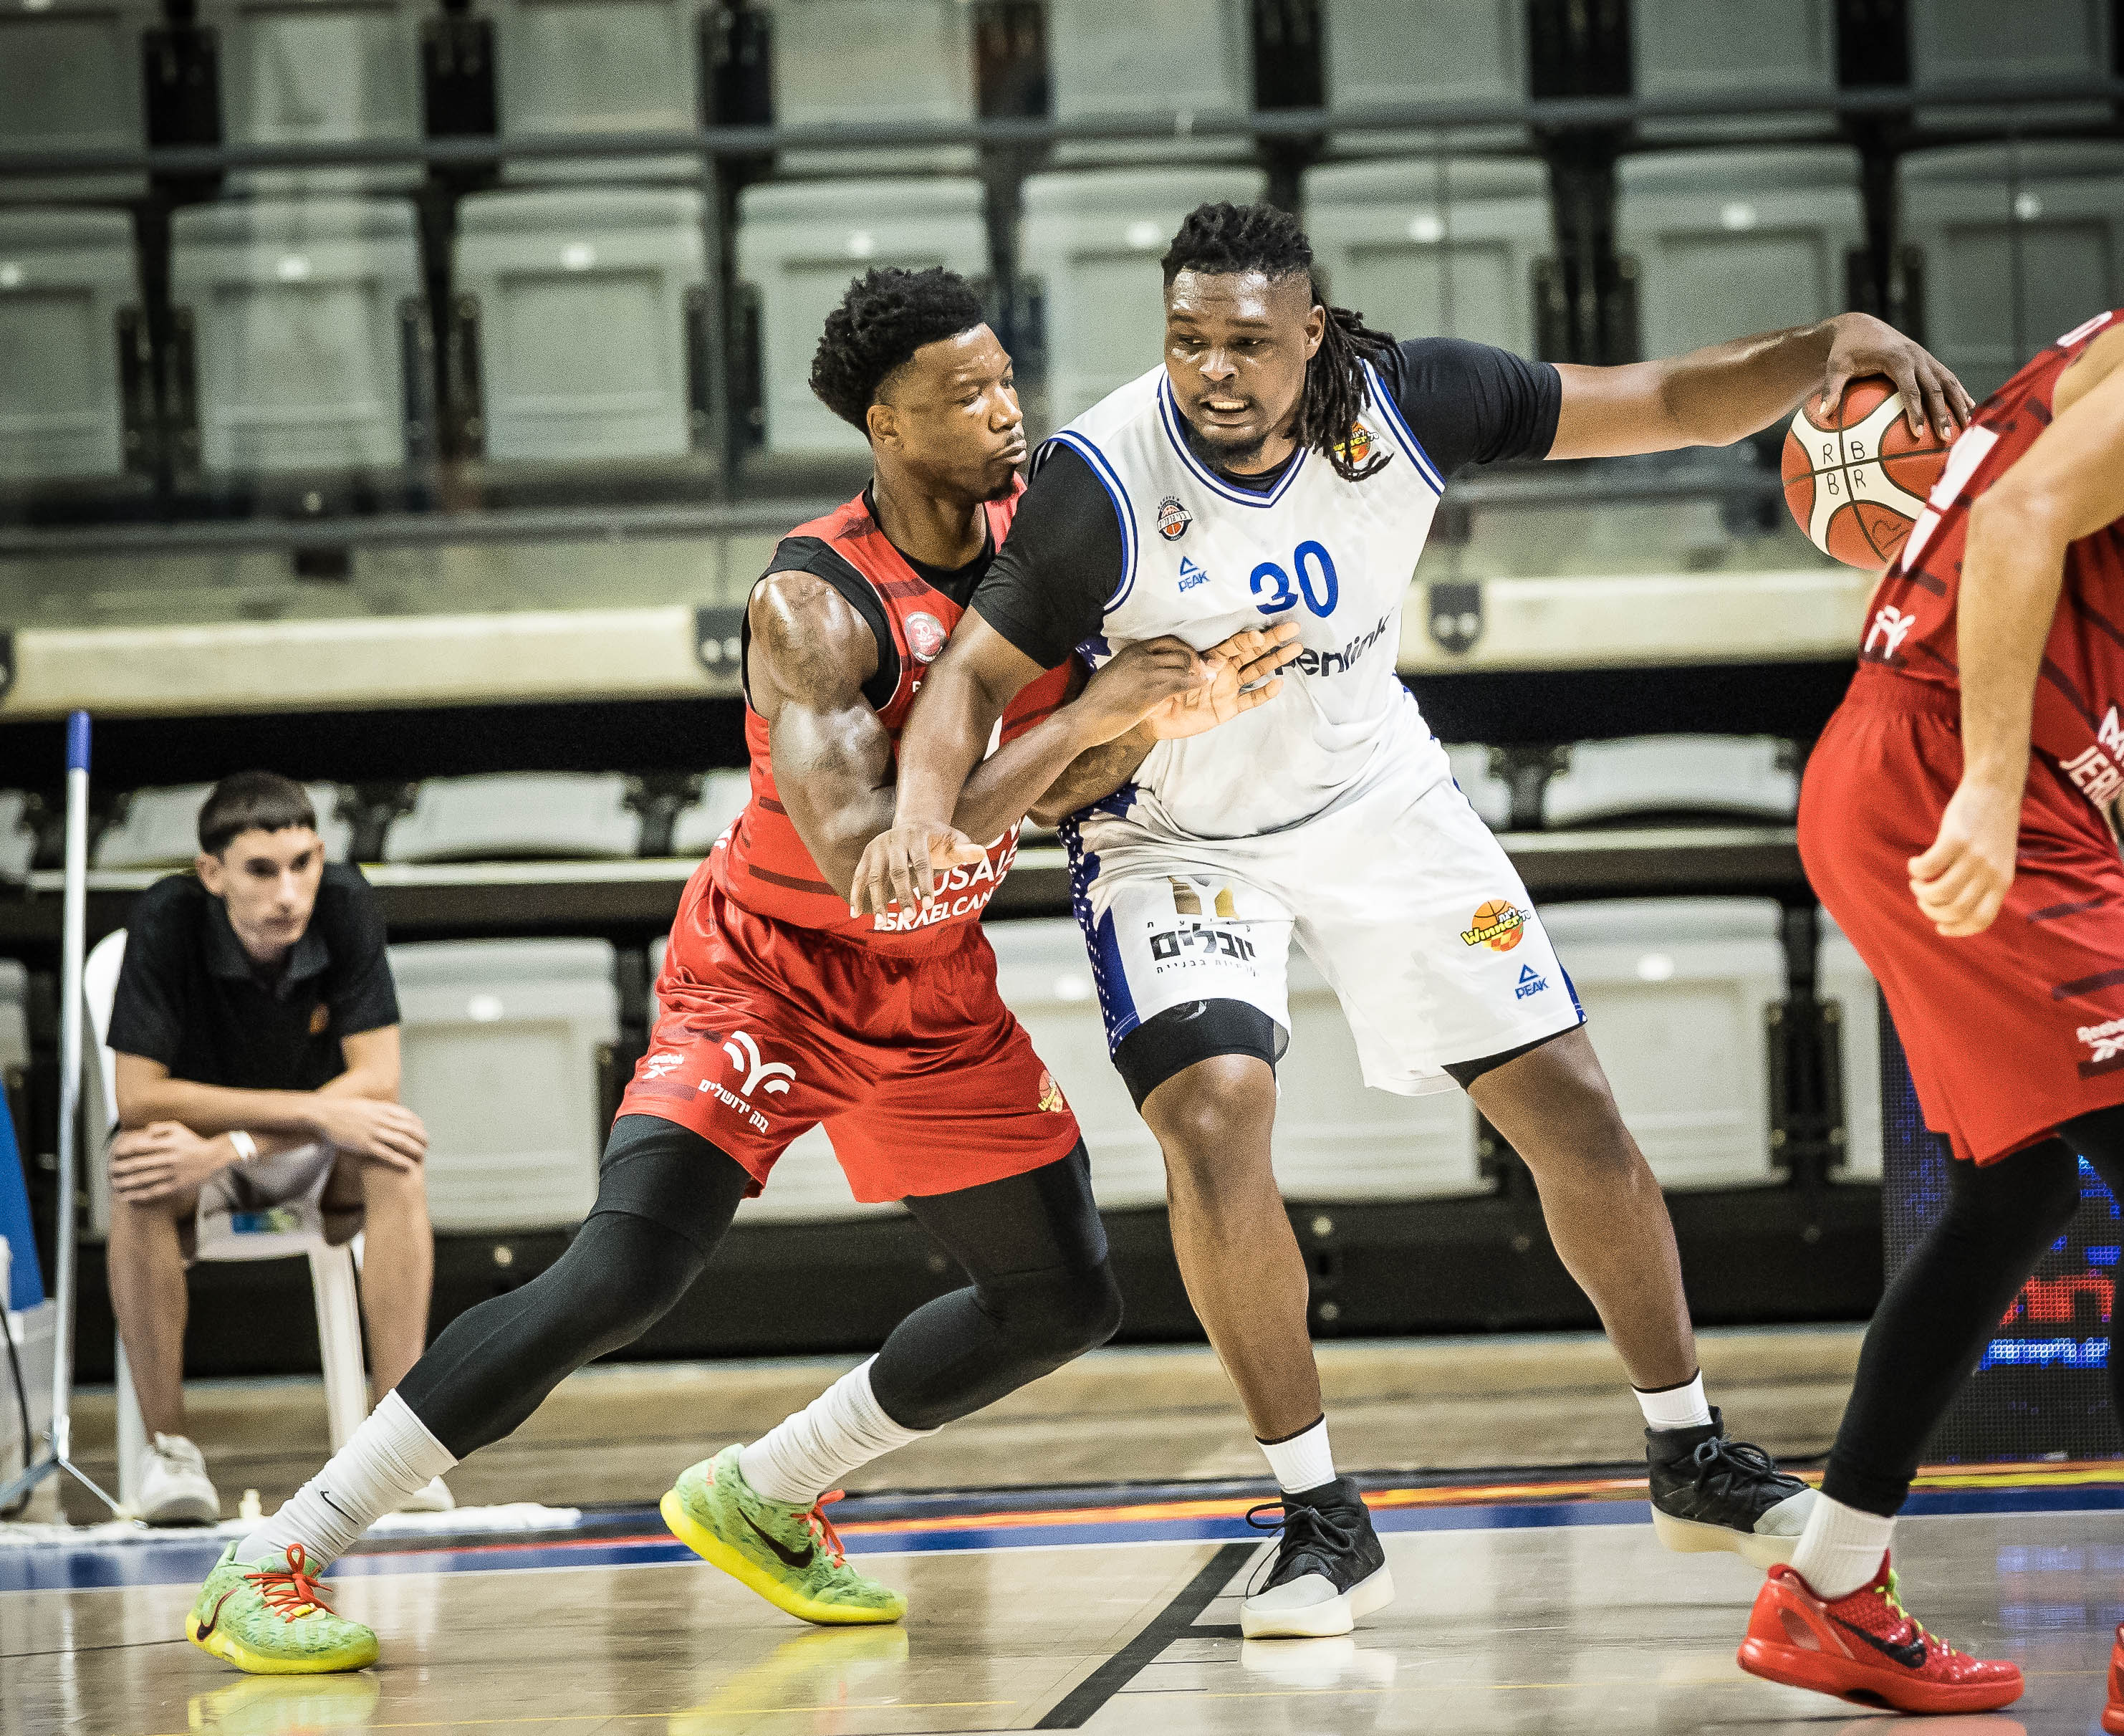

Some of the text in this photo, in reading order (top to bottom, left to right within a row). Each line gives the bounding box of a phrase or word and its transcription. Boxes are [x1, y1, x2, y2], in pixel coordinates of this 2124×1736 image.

[1823, 441, 1866, 464] R B
[1827, 469, 1866, 495] B R
[1177, 570, 1211, 593] PEAK
[1249, 540, 1339, 618] 30
[1460, 915, 1520, 946] Winner
[1515, 977, 1550, 999] PEAK
[697, 1078, 751, 1115] ירושלים
